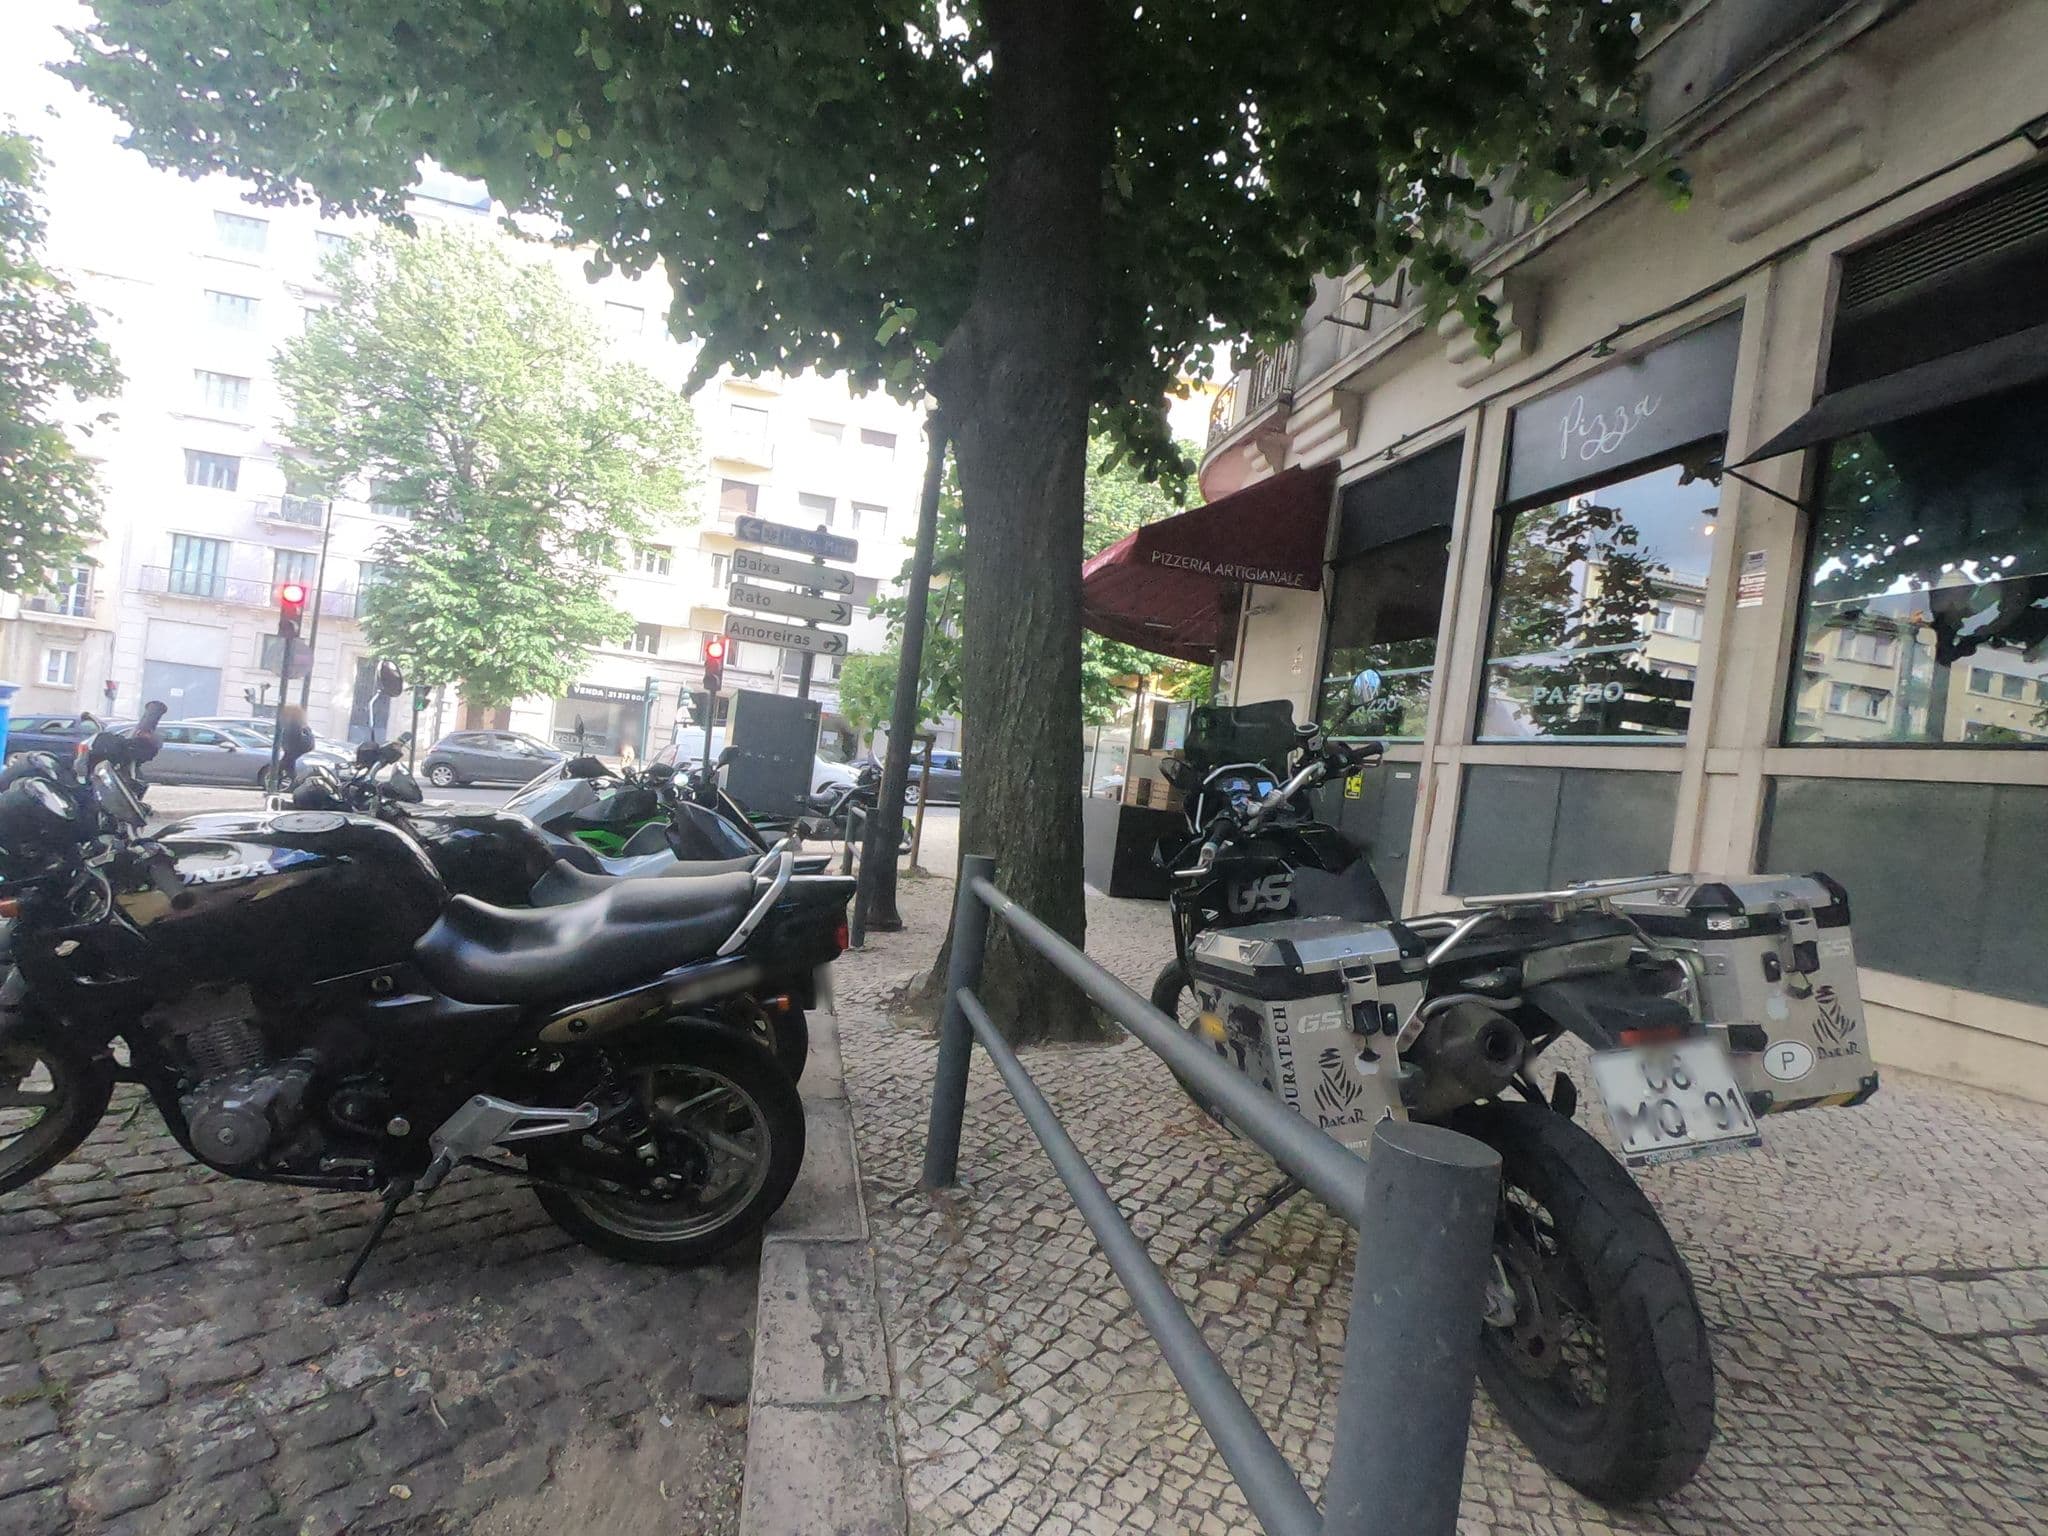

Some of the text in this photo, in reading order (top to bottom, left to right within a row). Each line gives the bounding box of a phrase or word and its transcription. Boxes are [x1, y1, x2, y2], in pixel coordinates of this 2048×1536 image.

[1560, 395, 1662, 461] Pizza
[737, 555, 781, 575] Baixa
[1151, 550, 1304, 586] PIZZERIA ARTIGIANALE
[734, 588, 772, 607] Rato
[730, 621, 810, 646] Amoreiras
[574, 686, 604, 697] VENDA
[1532, 681, 1624, 705] PAZZO
[182, 860, 279, 884] NDA
[1227, 874, 1292, 914] GS
[1298, 1010, 1343, 1034] GS
[1781, 1051, 1795, 1071] P
